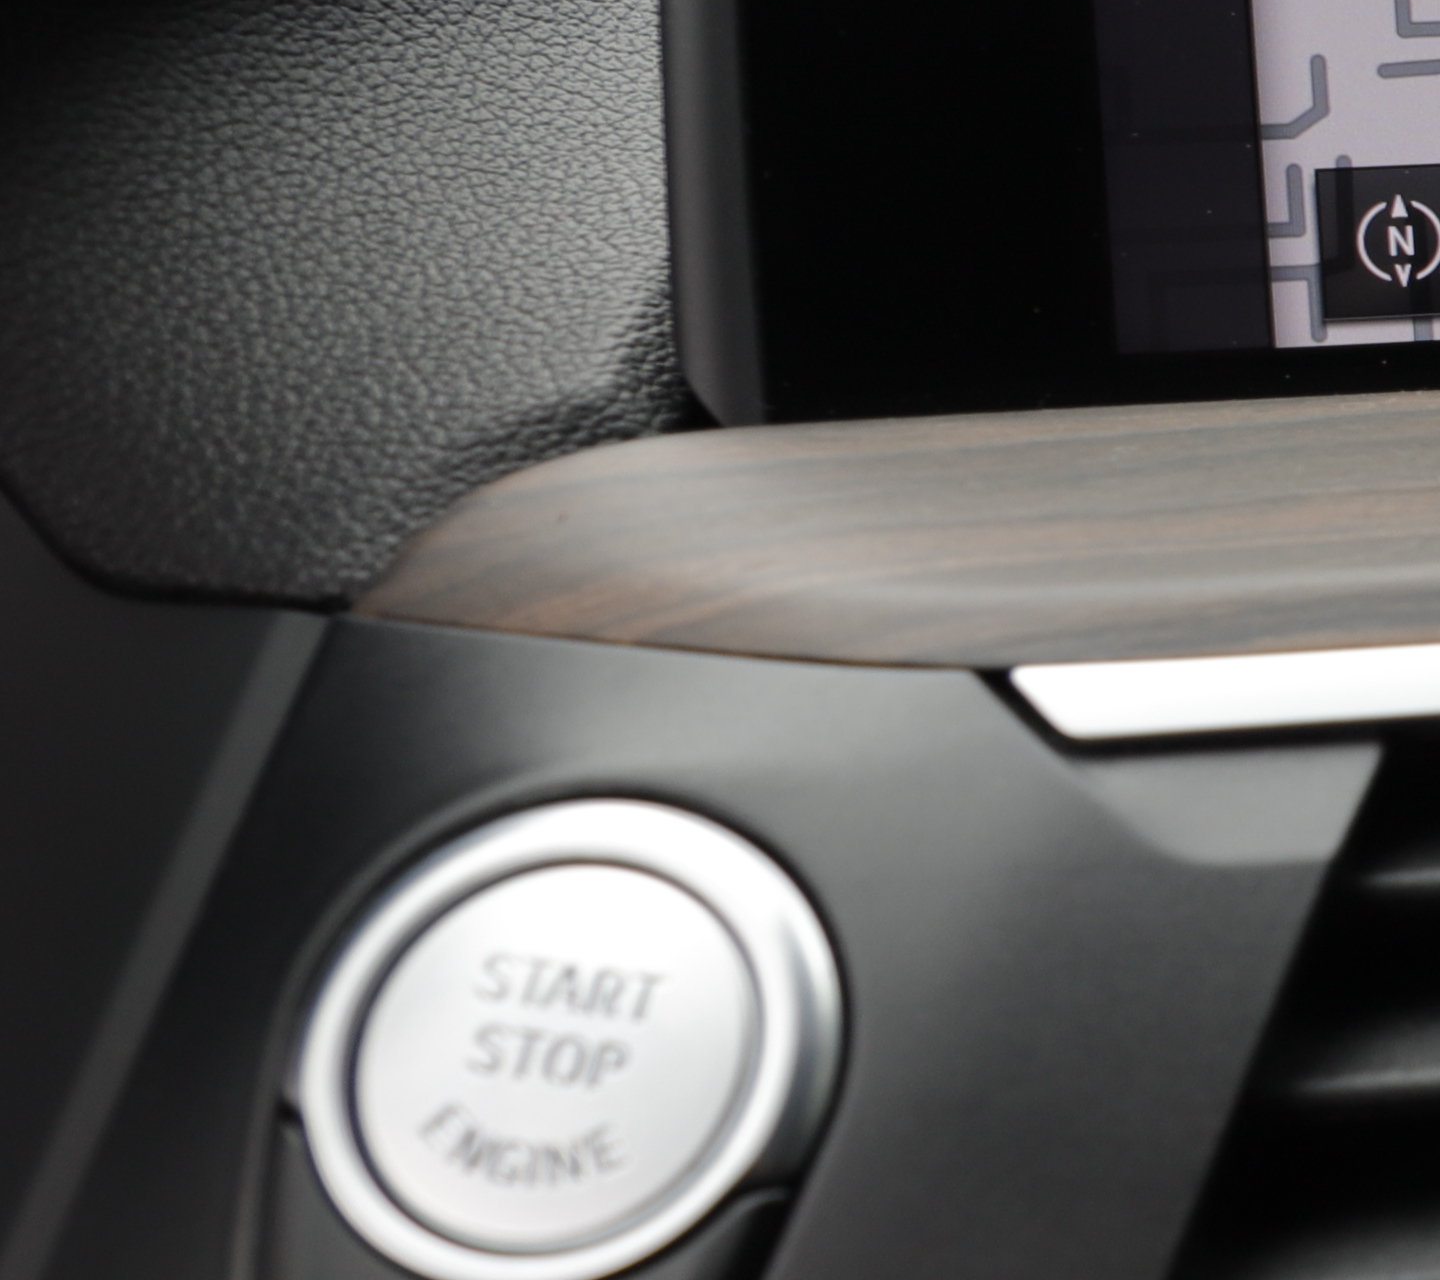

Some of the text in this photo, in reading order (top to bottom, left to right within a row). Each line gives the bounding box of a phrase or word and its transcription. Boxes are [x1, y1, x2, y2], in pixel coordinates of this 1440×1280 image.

[474, 951, 668, 1024] START
[466, 1022, 634, 1092] STOP
[418, 1100, 630, 1188] ENGINE
